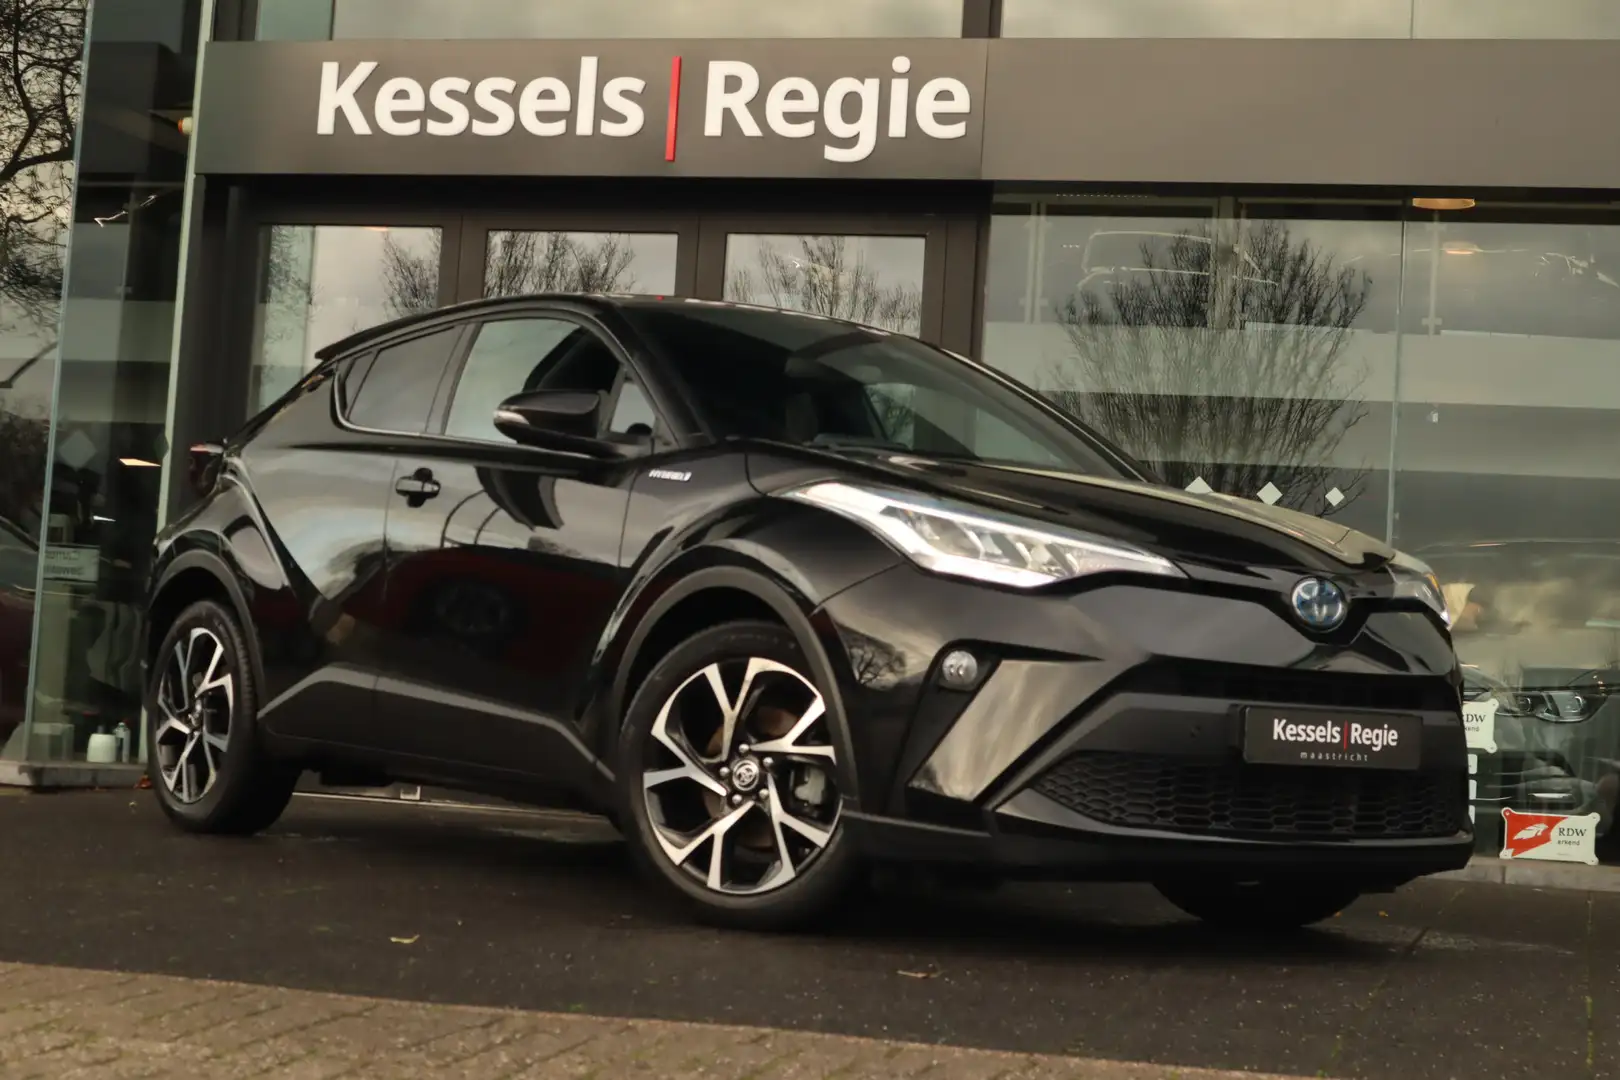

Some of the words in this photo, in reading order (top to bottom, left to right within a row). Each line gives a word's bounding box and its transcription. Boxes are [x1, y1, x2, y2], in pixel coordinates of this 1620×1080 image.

[317, 56, 647, 137] Kessels
[704, 55, 971, 163] Regie
[1462, 713, 1487, 723] DW
[1273, 718, 1341, 743] Kessels
[1350, 722, 1399, 751] Regie
[1300, 751, 1368, 762] maastricht
[1558, 827, 1588, 837] RDW
[1557, 839, 1581, 847] erkend
